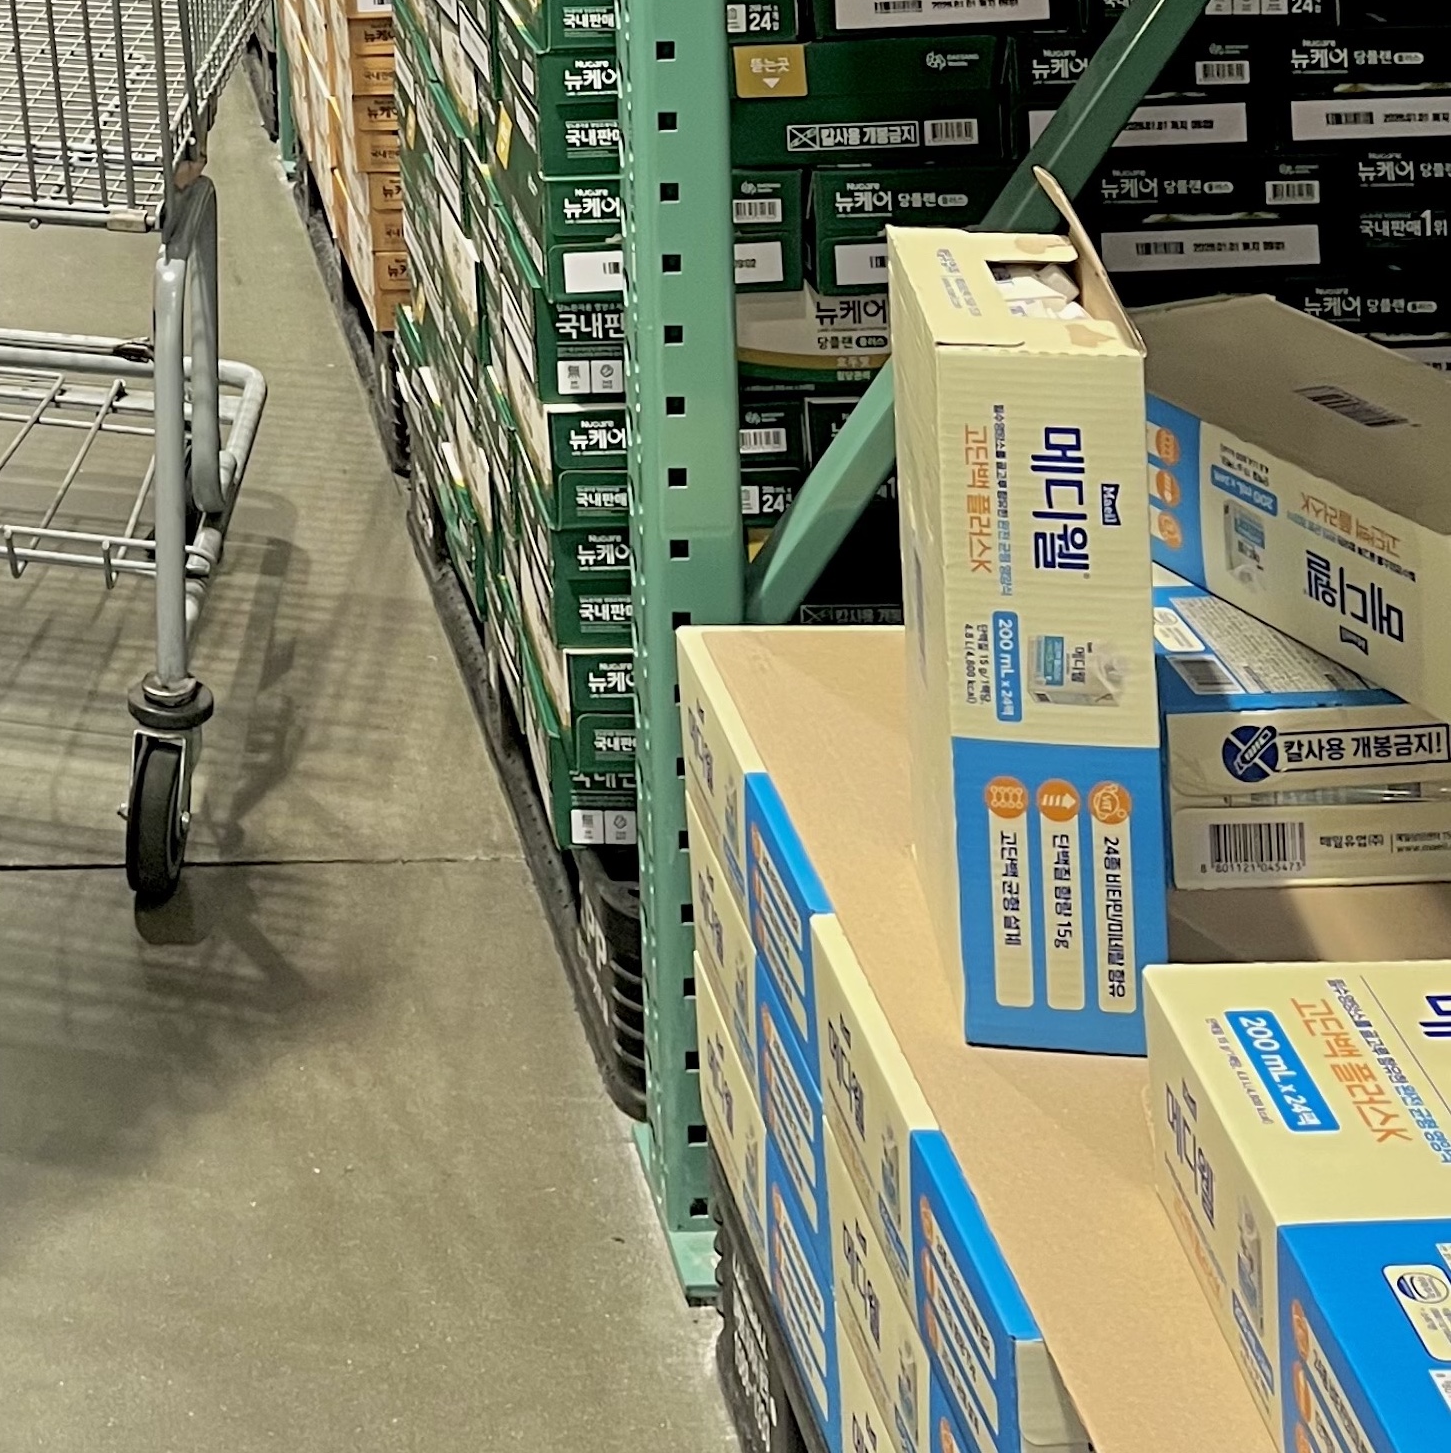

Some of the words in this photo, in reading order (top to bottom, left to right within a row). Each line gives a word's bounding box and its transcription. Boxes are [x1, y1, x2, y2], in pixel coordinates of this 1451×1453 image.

[574, 60, 610, 68] Nucare
[1290, 47, 1348, 70] 뉴케어
[1358, 160, 1415, 182] 뉴케어
[835, 191, 893, 213] 뉴케어
[1101, 177, 1158, 199] 뉴케어
[815, 299, 888, 326] 뉴케어
[1304, 296, 1361, 318] 뉴케어
[964, 422, 990, 490] 고단백
[1030, 426, 1090, 570] 메디웰
[1101, 484, 1118, 525] Maeil
[966, 492, 993, 574] 플러스K
[1305, 548, 1404, 643] 메디웰
[998, 618, 1014, 650] 200
[999, 653, 1015, 678] mL
[1283, 736, 1346, 763] 칼사용
[1352, 731, 1442, 758] 개봉금지!
[1000, 830, 1019, 878] 고단백
[1052, 833, 1071, 881] 단백질
[1002, 880, 1020, 912] 균형
[1003, 915, 1022, 946] 설계
[1054, 922, 1073, 949] 15g
[1238, 1016, 1280, 1054] 200
[1261, 1053, 1297, 1085] mL
[828, 1018, 866, 1143] 메디웰
[1290, 997, 1363, 1058] 고단백
[1330, 1061, 1414, 1144] 플러스K
[1164, 1081, 1216, 1230] 메디웰
[842, 1219, 881, 1350] 메디웰
